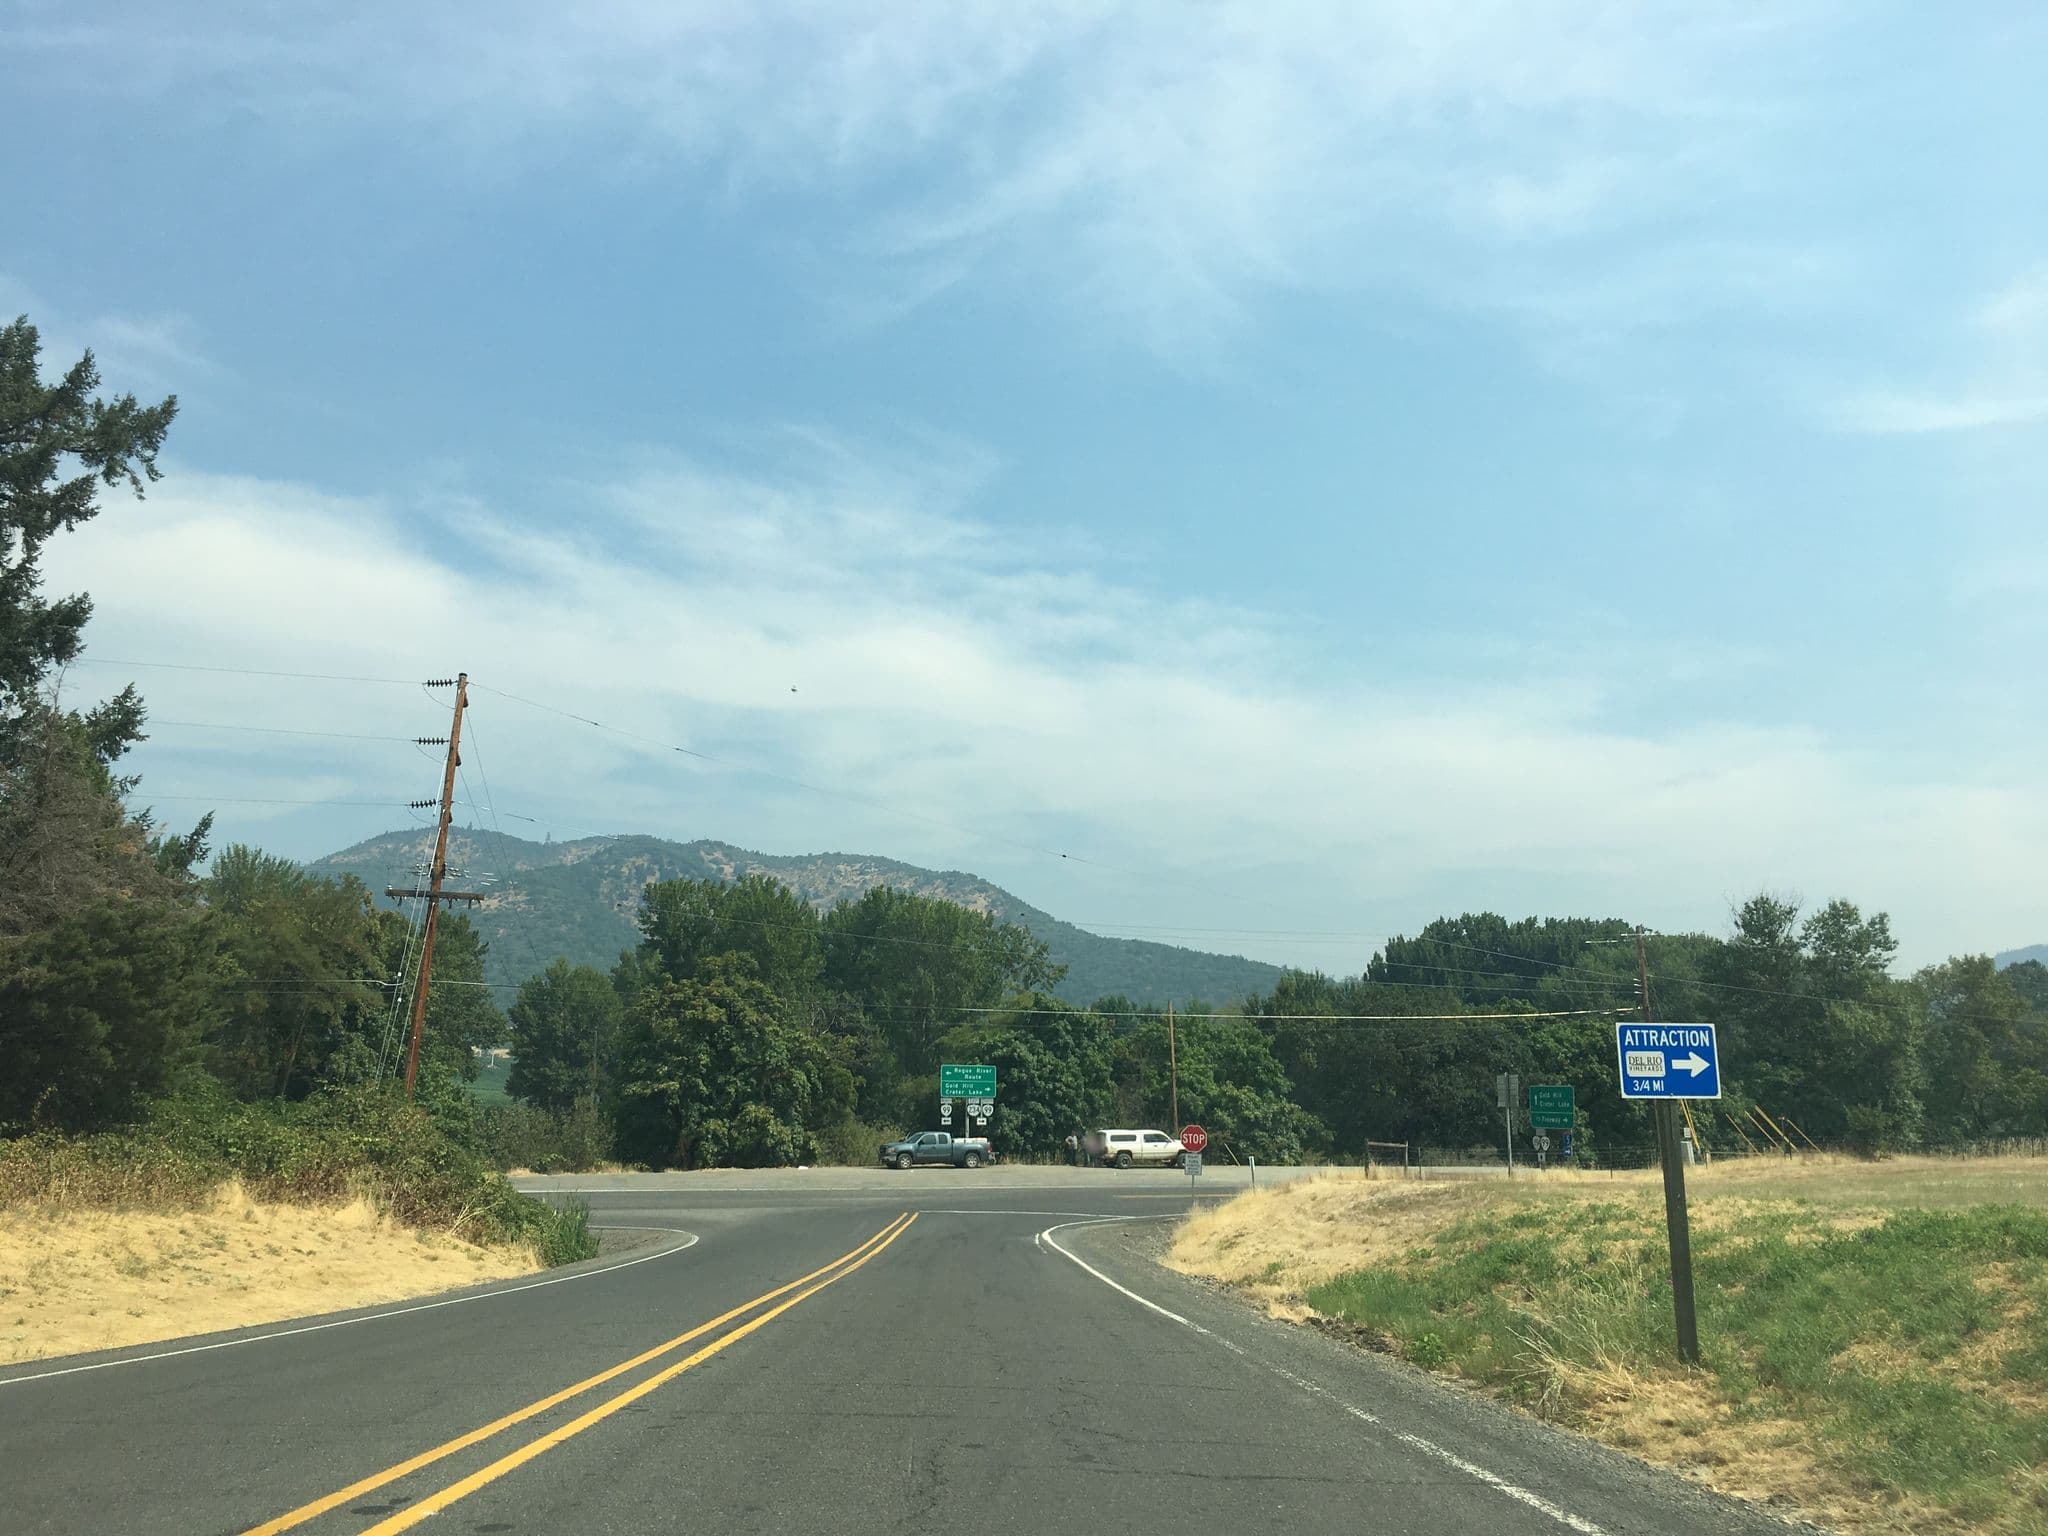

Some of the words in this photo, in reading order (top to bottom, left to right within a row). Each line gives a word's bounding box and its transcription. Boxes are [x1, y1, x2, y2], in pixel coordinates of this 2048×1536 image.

[1624, 1029, 1710, 1047] ATTRACTION
[1628, 1056, 1645, 1065] DEL
[1646, 1056, 1663, 1065] RIO
[1632, 1079, 1650, 1092] 3/4
[1652, 1079, 1665, 1092] MI
[1182, 1133, 1205, 1144] STOP
